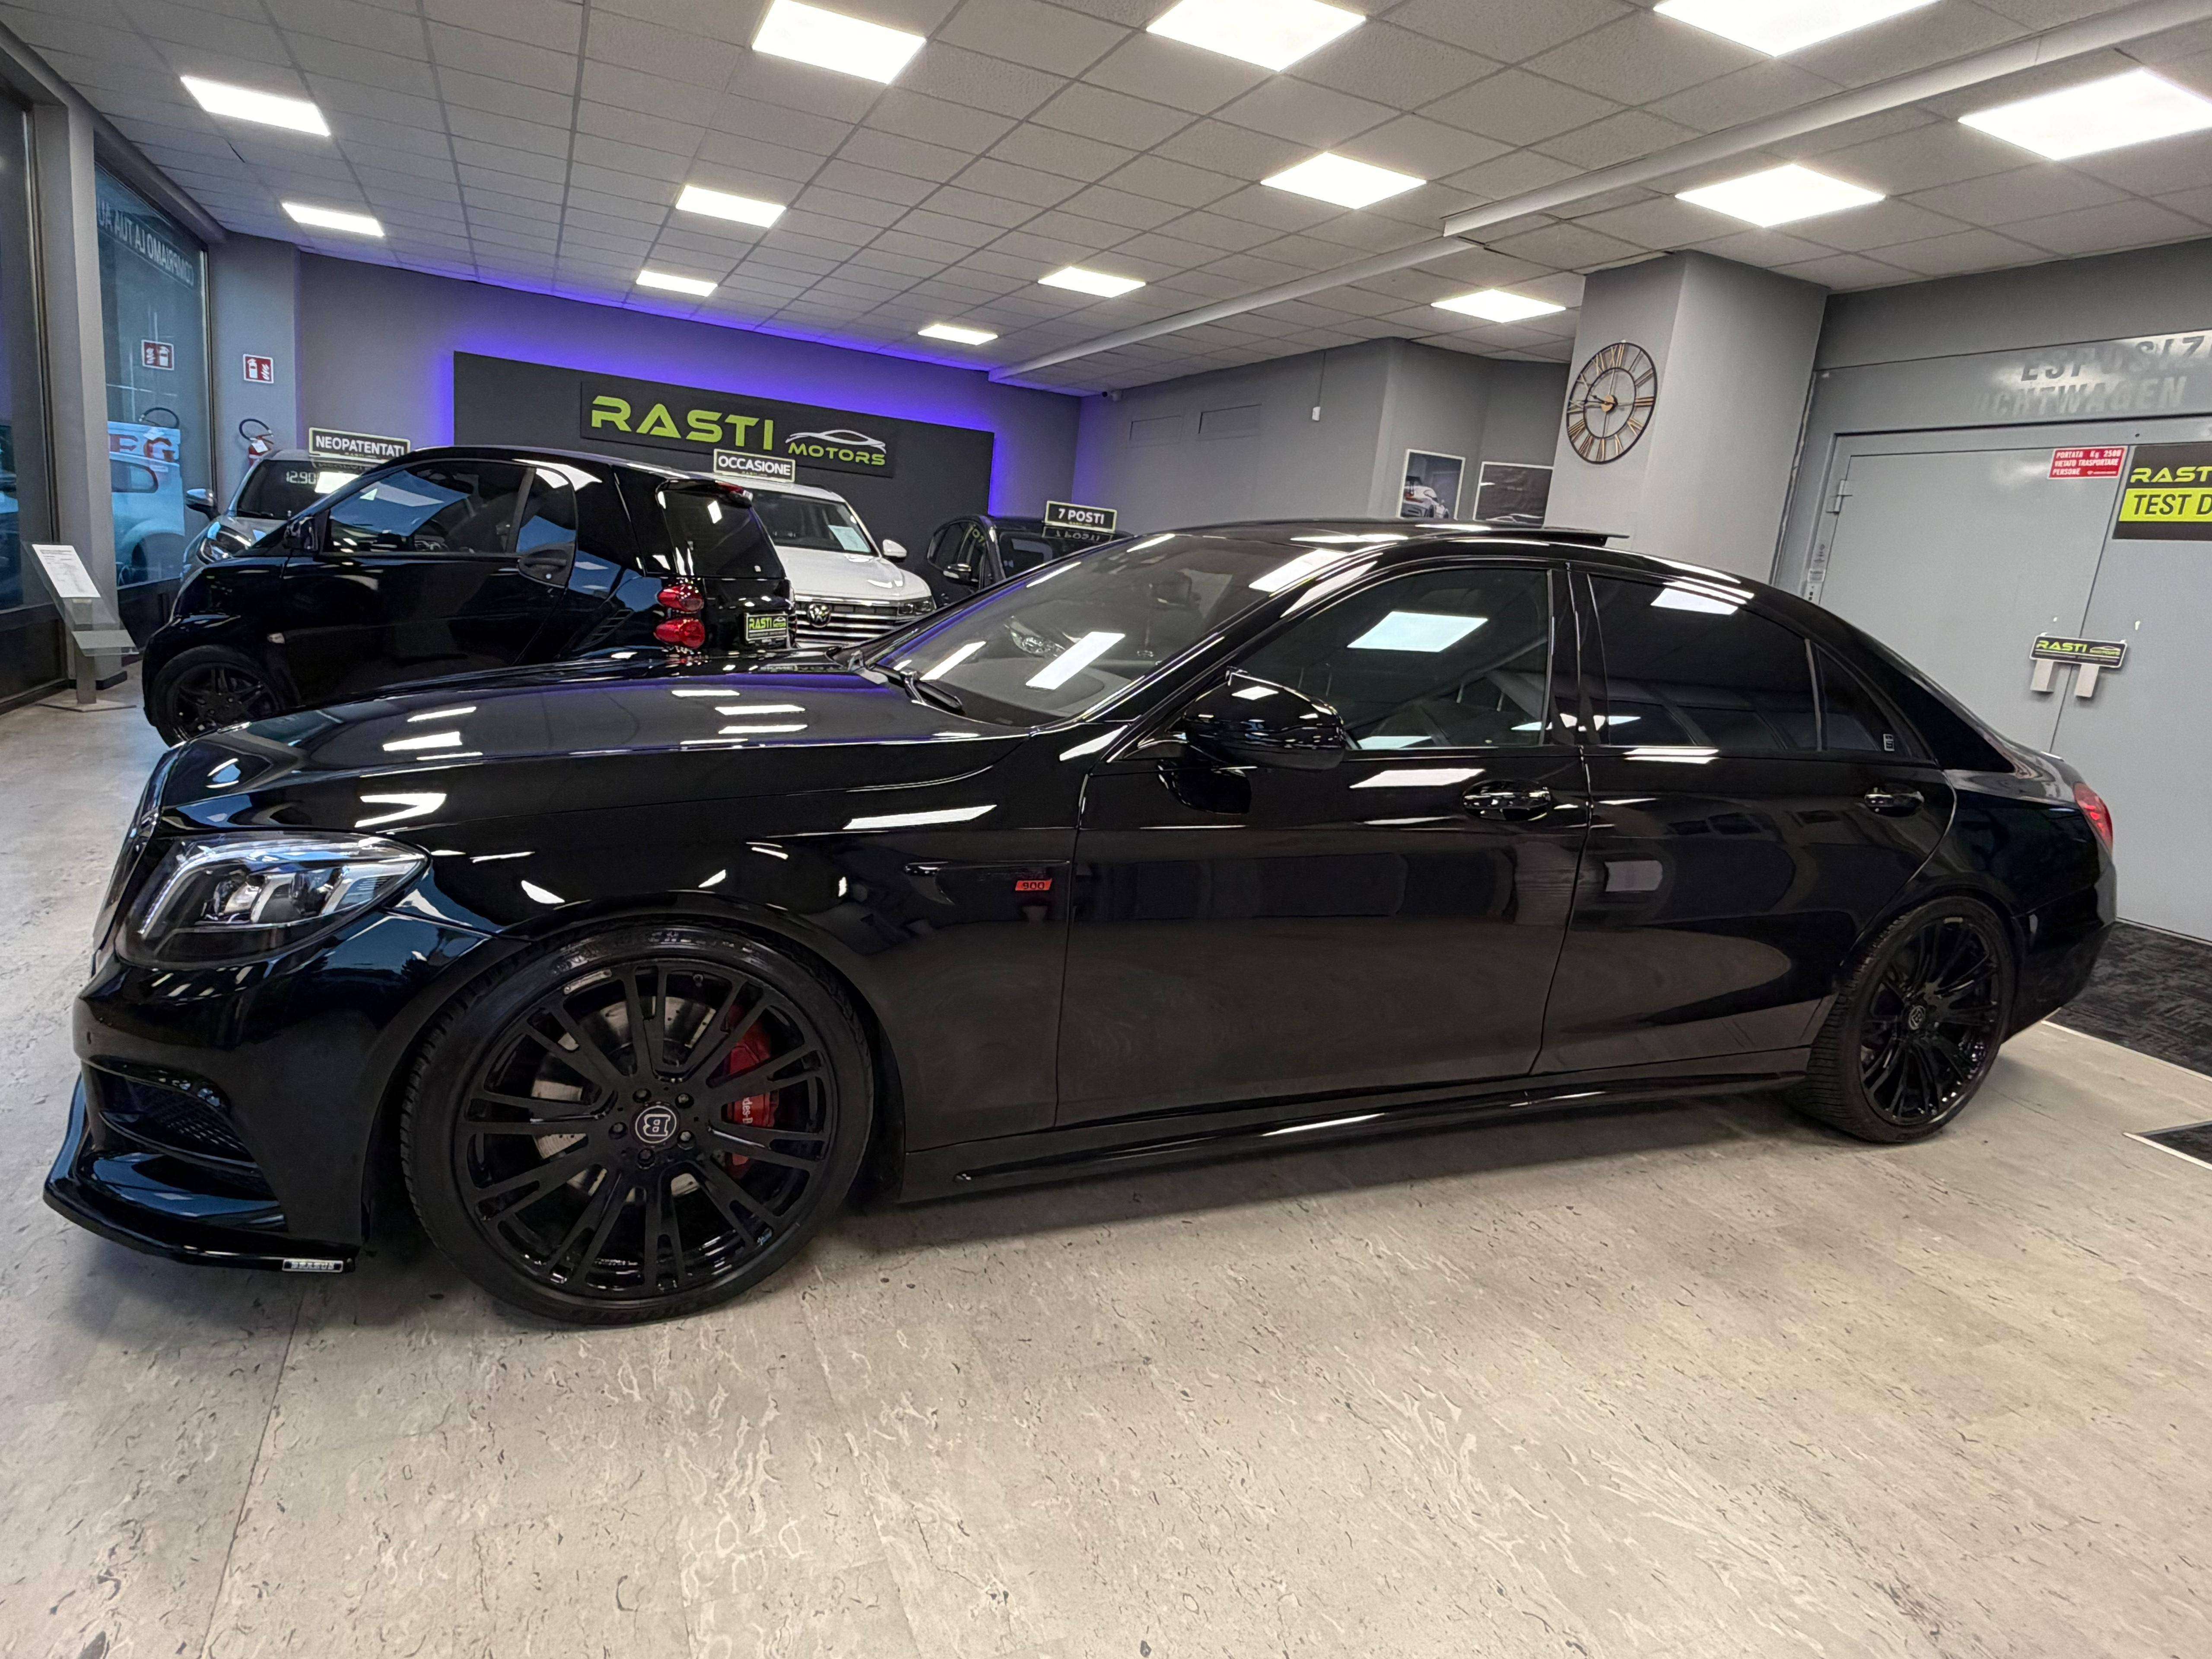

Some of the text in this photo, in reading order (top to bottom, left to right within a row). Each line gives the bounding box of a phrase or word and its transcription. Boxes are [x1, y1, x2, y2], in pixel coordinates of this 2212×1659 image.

[591, 395, 886, 466] RASTI MOTORS
[316, 435, 404, 457] NEOPATENTATI
[2089, 450, 2100, 458] Kg
[718, 455, 791, 476] OCCASIONE
[2078, 458, 2120, 467] TRASPORTARE
[2133, 494, 2192, 515] TEST
[1058, 508, 1066, 519] 7
[1068, 510, 1105, 524] POSTI
[749, 617, 772, 630] RASTI
[2036, 640, 2088, 653] RASTI
[1022, 881, 1045, 890] 900
[643, 1113, 671, 1137] B
